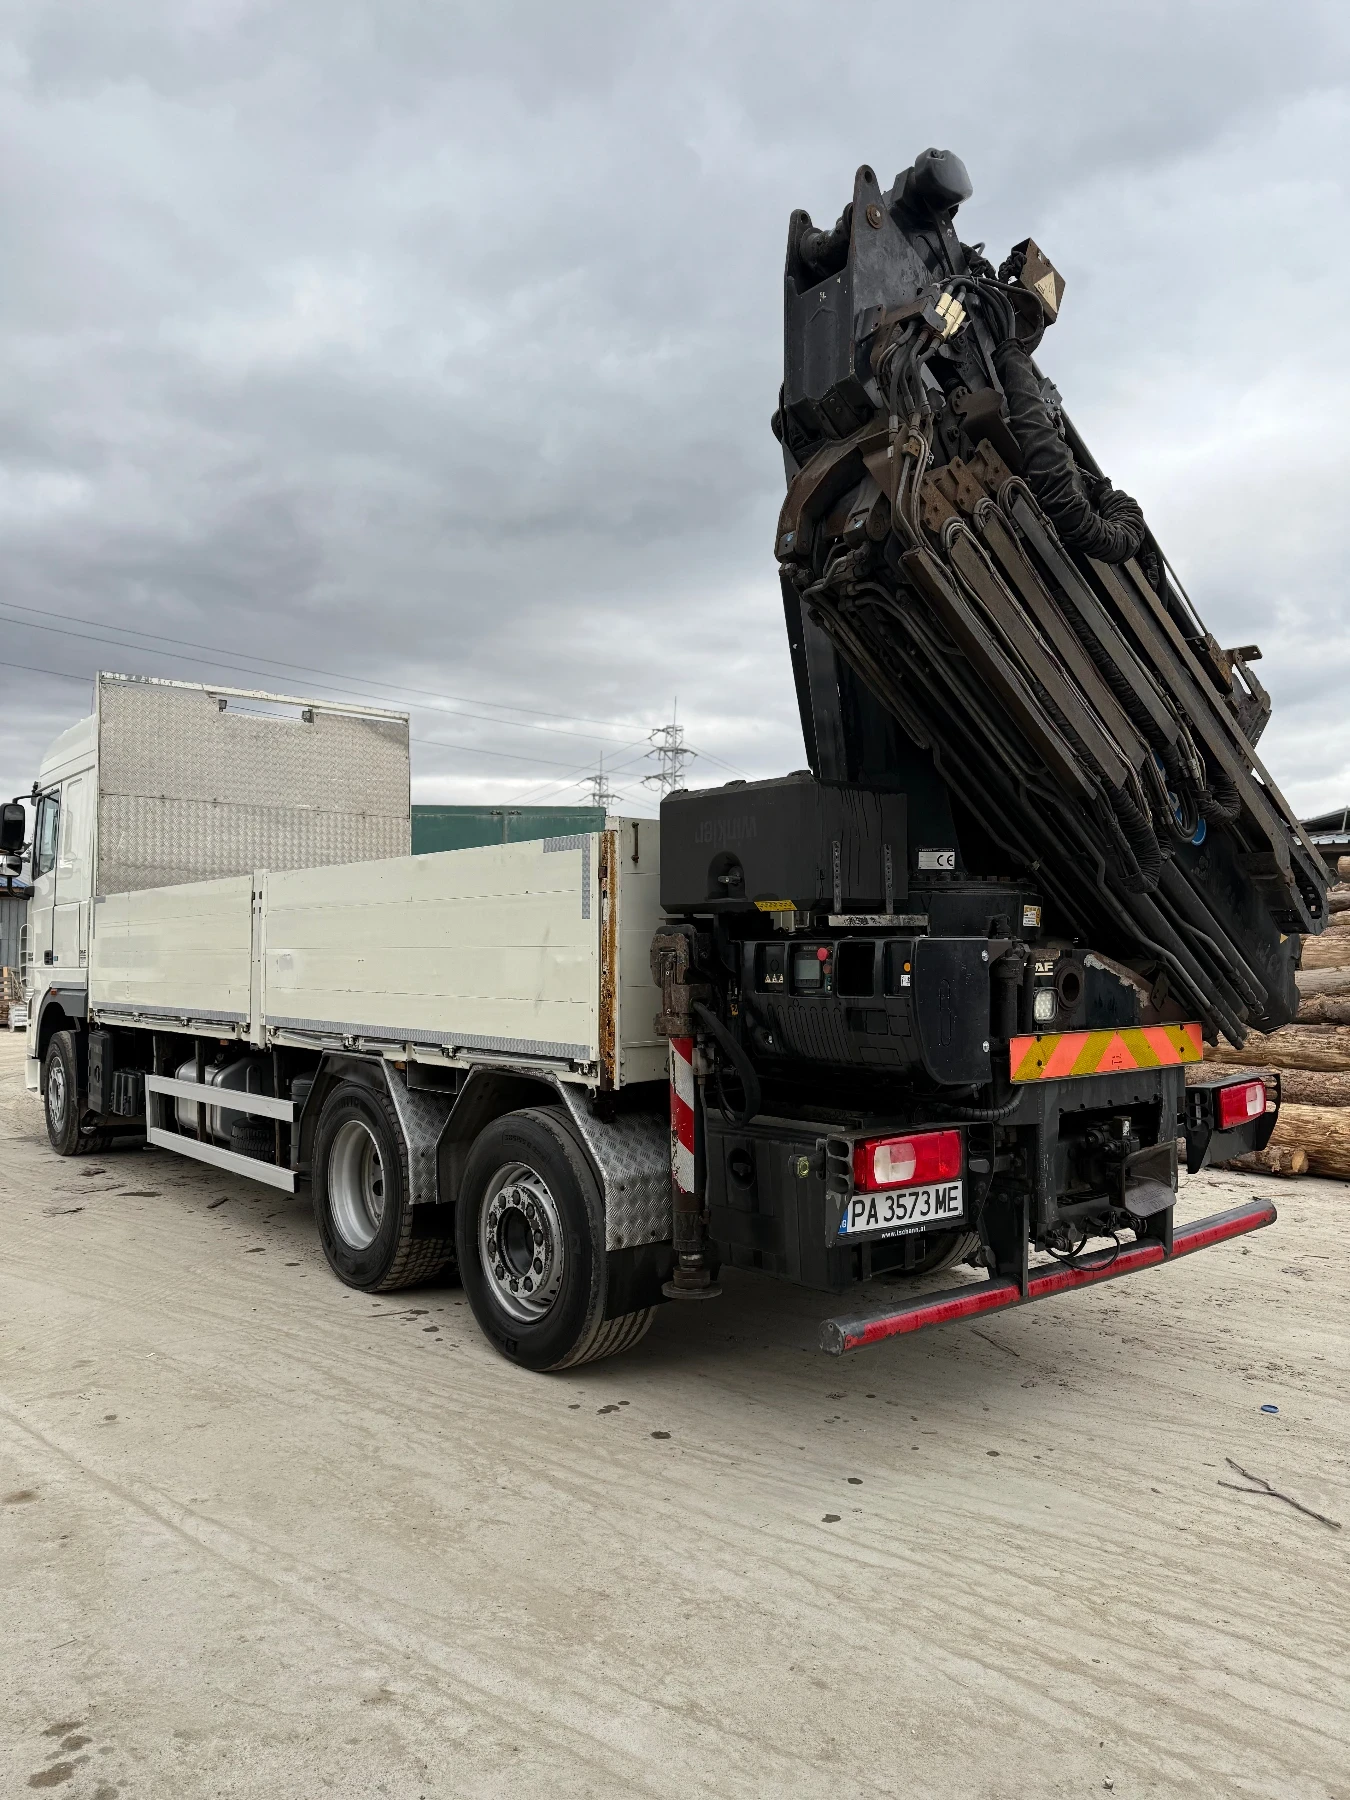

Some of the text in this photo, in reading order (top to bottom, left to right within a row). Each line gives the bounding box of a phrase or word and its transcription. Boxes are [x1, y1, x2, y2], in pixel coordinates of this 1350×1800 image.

[937, 854, 954, 867] CE
[851, 1185, 959, 1228] PA 3573 ME
